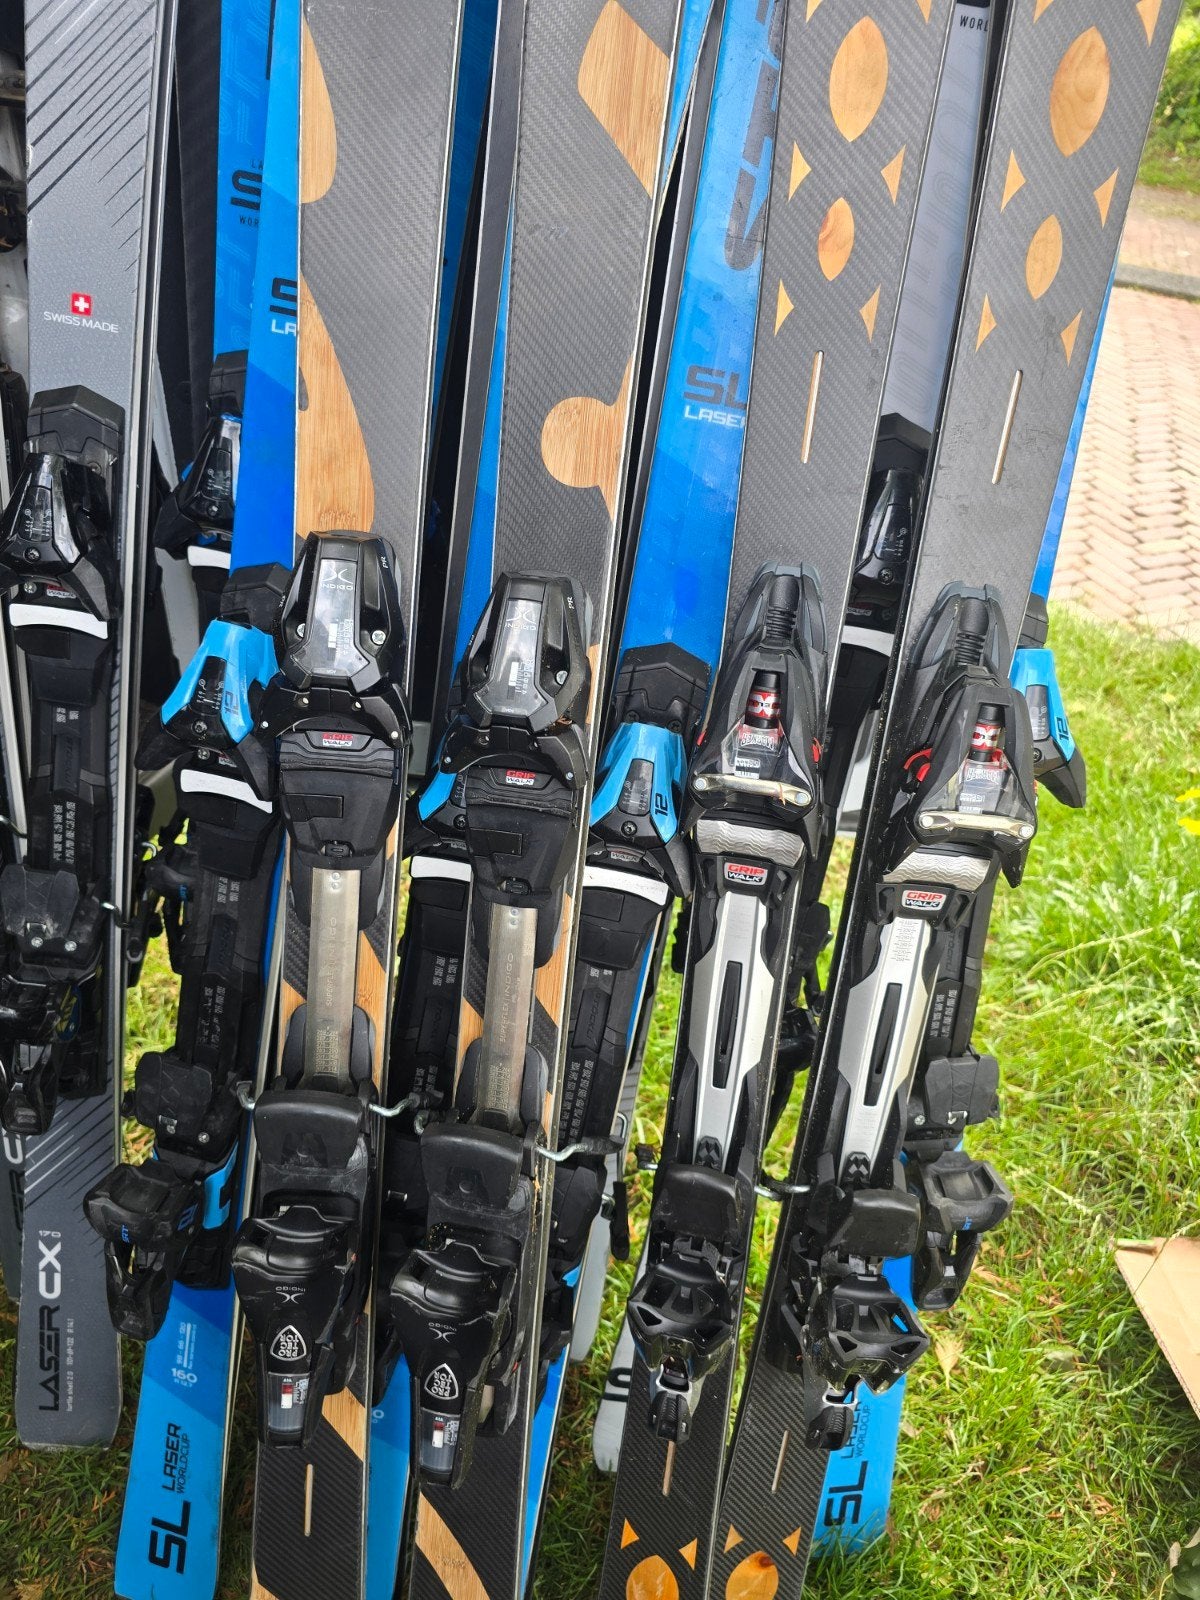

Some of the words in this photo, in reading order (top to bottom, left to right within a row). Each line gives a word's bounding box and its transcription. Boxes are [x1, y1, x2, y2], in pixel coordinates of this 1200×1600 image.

[43, 311, 80, 326] SWISS
[82, 318, 119, 333] MADE
[320, 583, 354, 591] INDIGO
[1055, 716, 1070, 741] 12
[322, 732, 353, 741] GRIP
[323, 739, 352, 747] WALK
[506, 769, 536, 779] GRIP
[506, 776, 534, 785] WALK
[654, 792, 668, 817] 12
[728, 864, 765, 876] GRIP
[728, 872, 761, 882] WALK
[906, 891, 943, 901] GRIP
[906, 899, 940, 908] WALK
[38, 1239, 62, 1300] CX
[428, 1322, 458, 1332] INDIGO
[280, 1334, 299, 1342] TOR
[280, 1341, 299, 1350] TEC
[38, 1304, 61, 1412] LASER
[278, 1349, 298, 1358] PRO
[171, 1367, 198, 1383] 160
[433, 1370, 452, 1383] TOR
[433, 1380, 451, 1390] TEC
[431, 1386, 450, 1397] PRO
[853, 1404, 871, 1458] WORLDCUP
[162, 1422, 182, 1491] LASER
[177, 1433, 191, 1494] WORLDCUP
[823, 1460, 869, 1527] SL
[148, 1500, 192, 1575] SL
